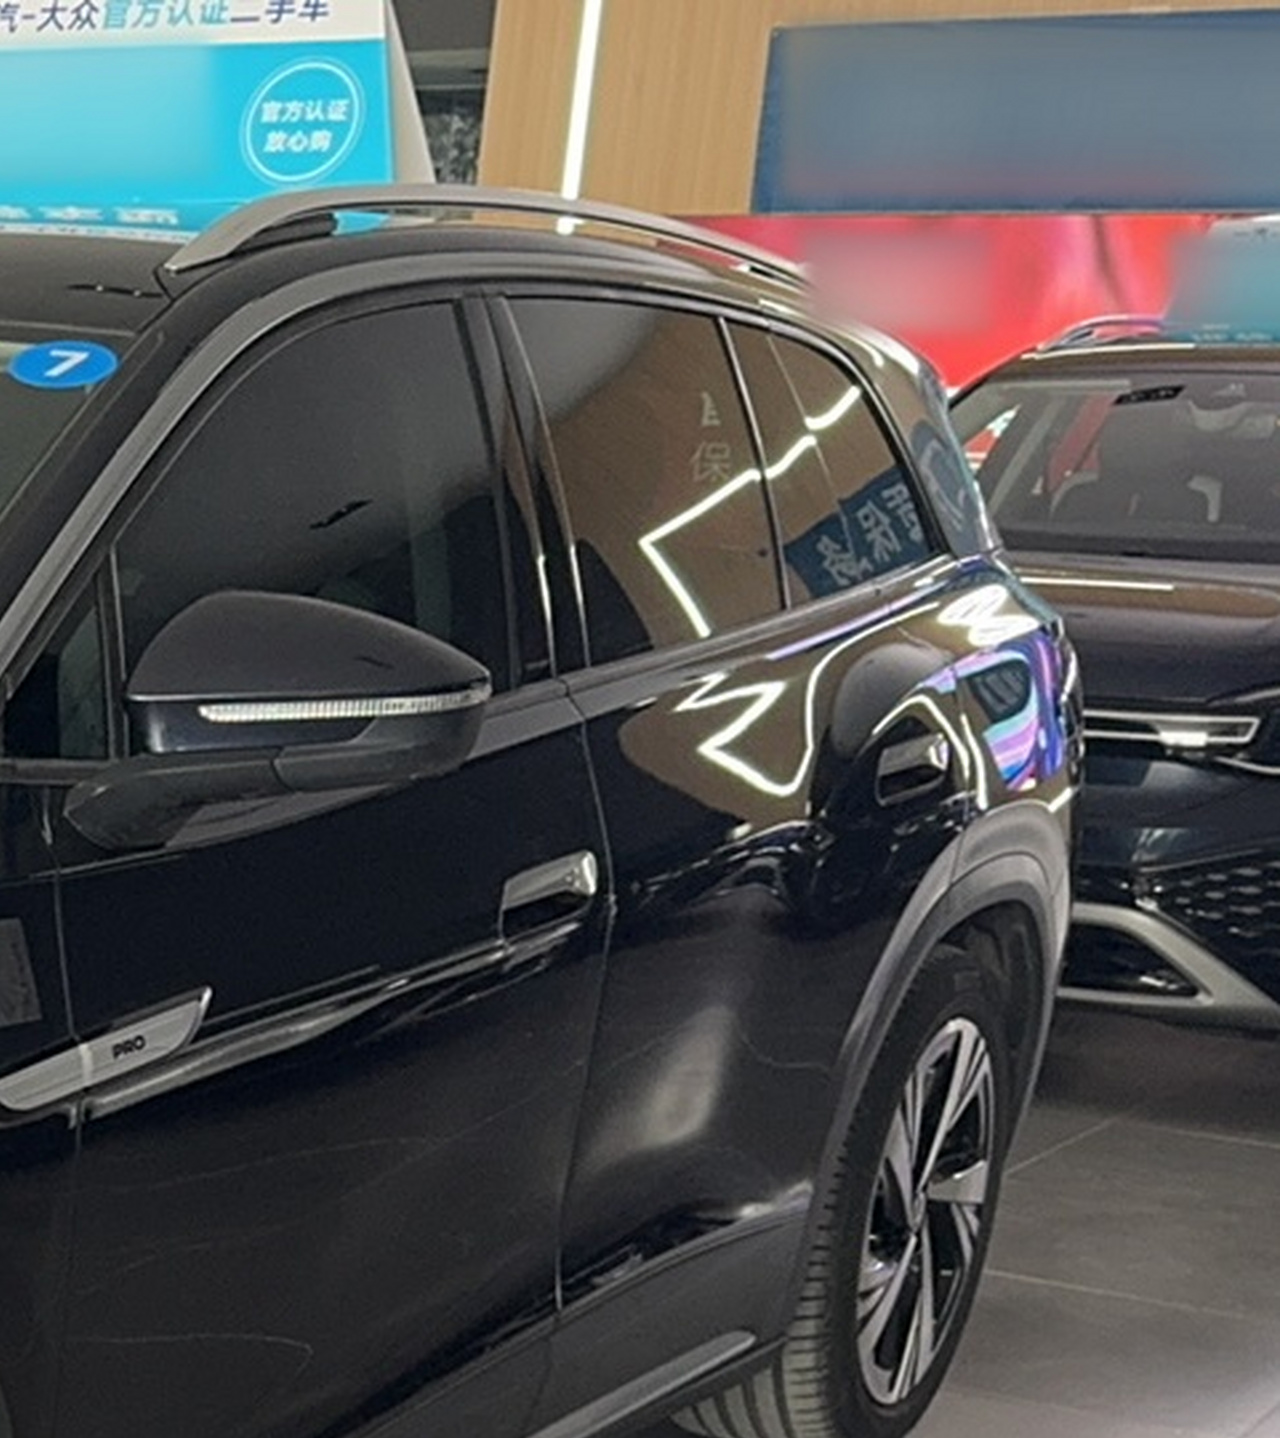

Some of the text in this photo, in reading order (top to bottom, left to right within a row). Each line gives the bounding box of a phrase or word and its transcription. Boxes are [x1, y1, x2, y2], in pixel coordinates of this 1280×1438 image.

[260, 100, 350, 123] 官方认证
[263, 129, 333, 152] 放心购
[44, 349, 90, 377] 7
[112, 1035, 146, 1059] PRO
